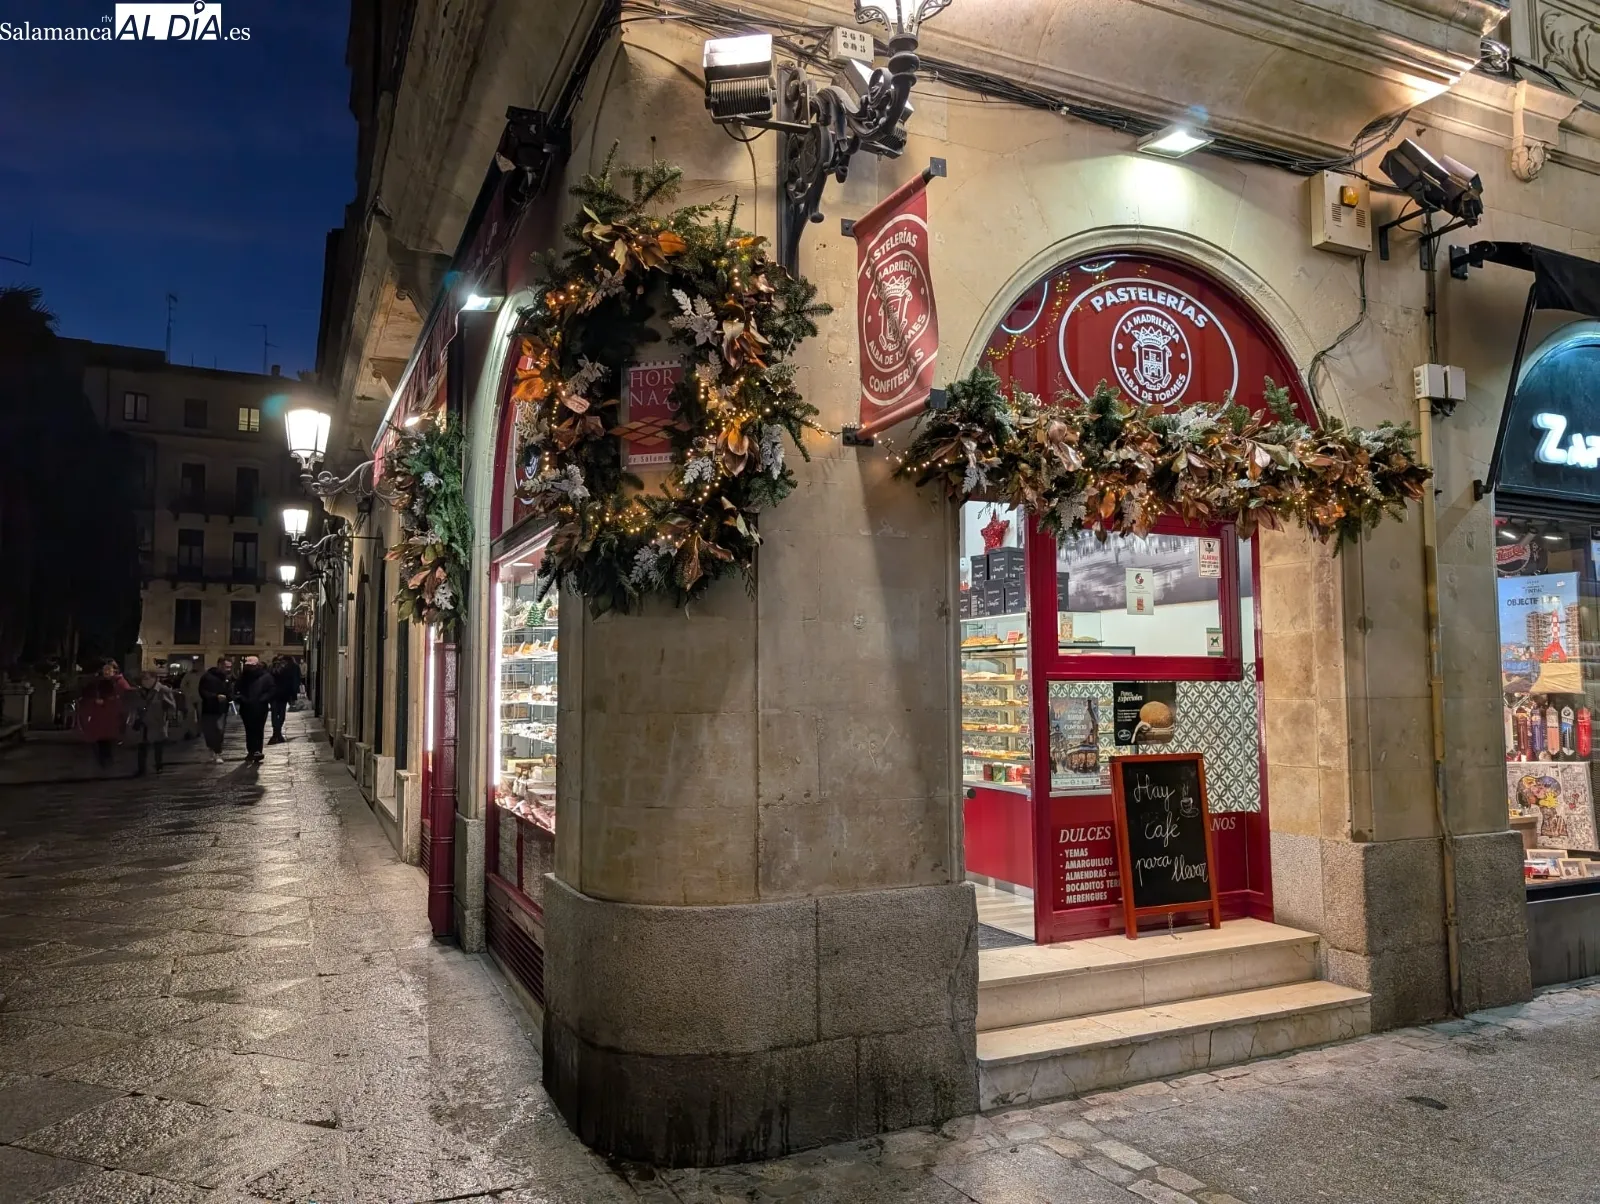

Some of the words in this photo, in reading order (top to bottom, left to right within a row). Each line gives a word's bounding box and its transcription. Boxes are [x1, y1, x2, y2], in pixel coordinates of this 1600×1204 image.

[1090, 286, 1208, 329] PASTELERÍAS
[1122, 321, 1134, 334] LA
[1132, 314, 1180, 344] MADRILEÑA
[868, 340, 883, 364] ALBA
[884, 355, 894, 365] DE
[630, 368, 675, 388] HOR
[1118, 366, 1140, 395] ALBA
[1141, 389, 1153, 401] DE
[1155, 372, 1187, 402] TORMES
[1133, 774, 1176, 812] Hay
[1059, 826, 1112, 843] DULCES
[1064, 848, 1089, 858] YEMAS
[1065, 857, 1113, 869] AMARGUILLOS
[1065, 869, 1107, 881] ALMENDRAS
[1135, 855, 1172, 888] para
[1171, 854, 1209, 883] llevar
[1065, 880, 1105, 893] BOCADITOS
[1066, 892, 1108, 904] MERENGUES
